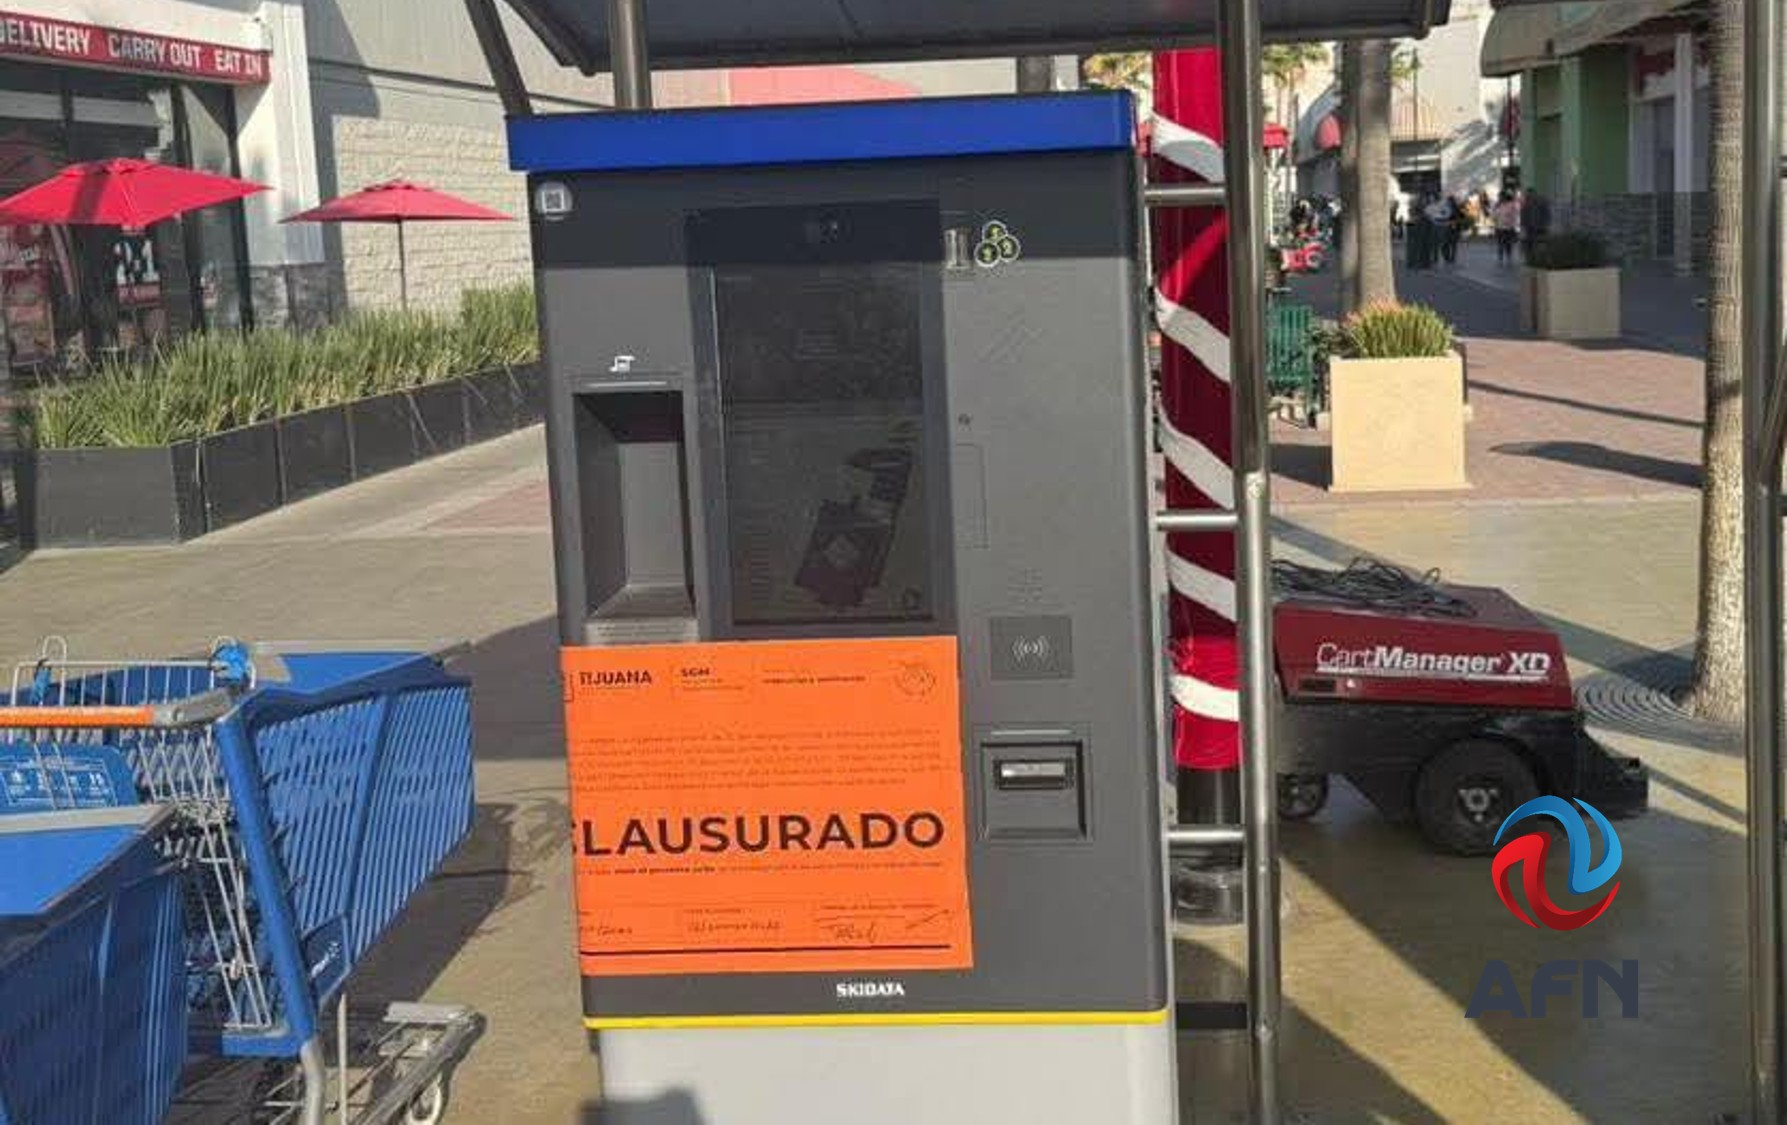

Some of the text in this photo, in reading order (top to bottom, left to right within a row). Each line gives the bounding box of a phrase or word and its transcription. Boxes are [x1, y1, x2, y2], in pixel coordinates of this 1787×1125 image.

[108, 33, 166, 63] CARRY
[169, 43, 201, 68] OUT
[215, 50, 242, 73] EAT
[246, 54, 262, 76] IN
[1316, 643, 1500, 674] CartManager
[579, 669, 652, 686] TIJUANA
[571, 811, 945, 856] LAUSURADO
[836, 983, 905, 997] SKIDATA
